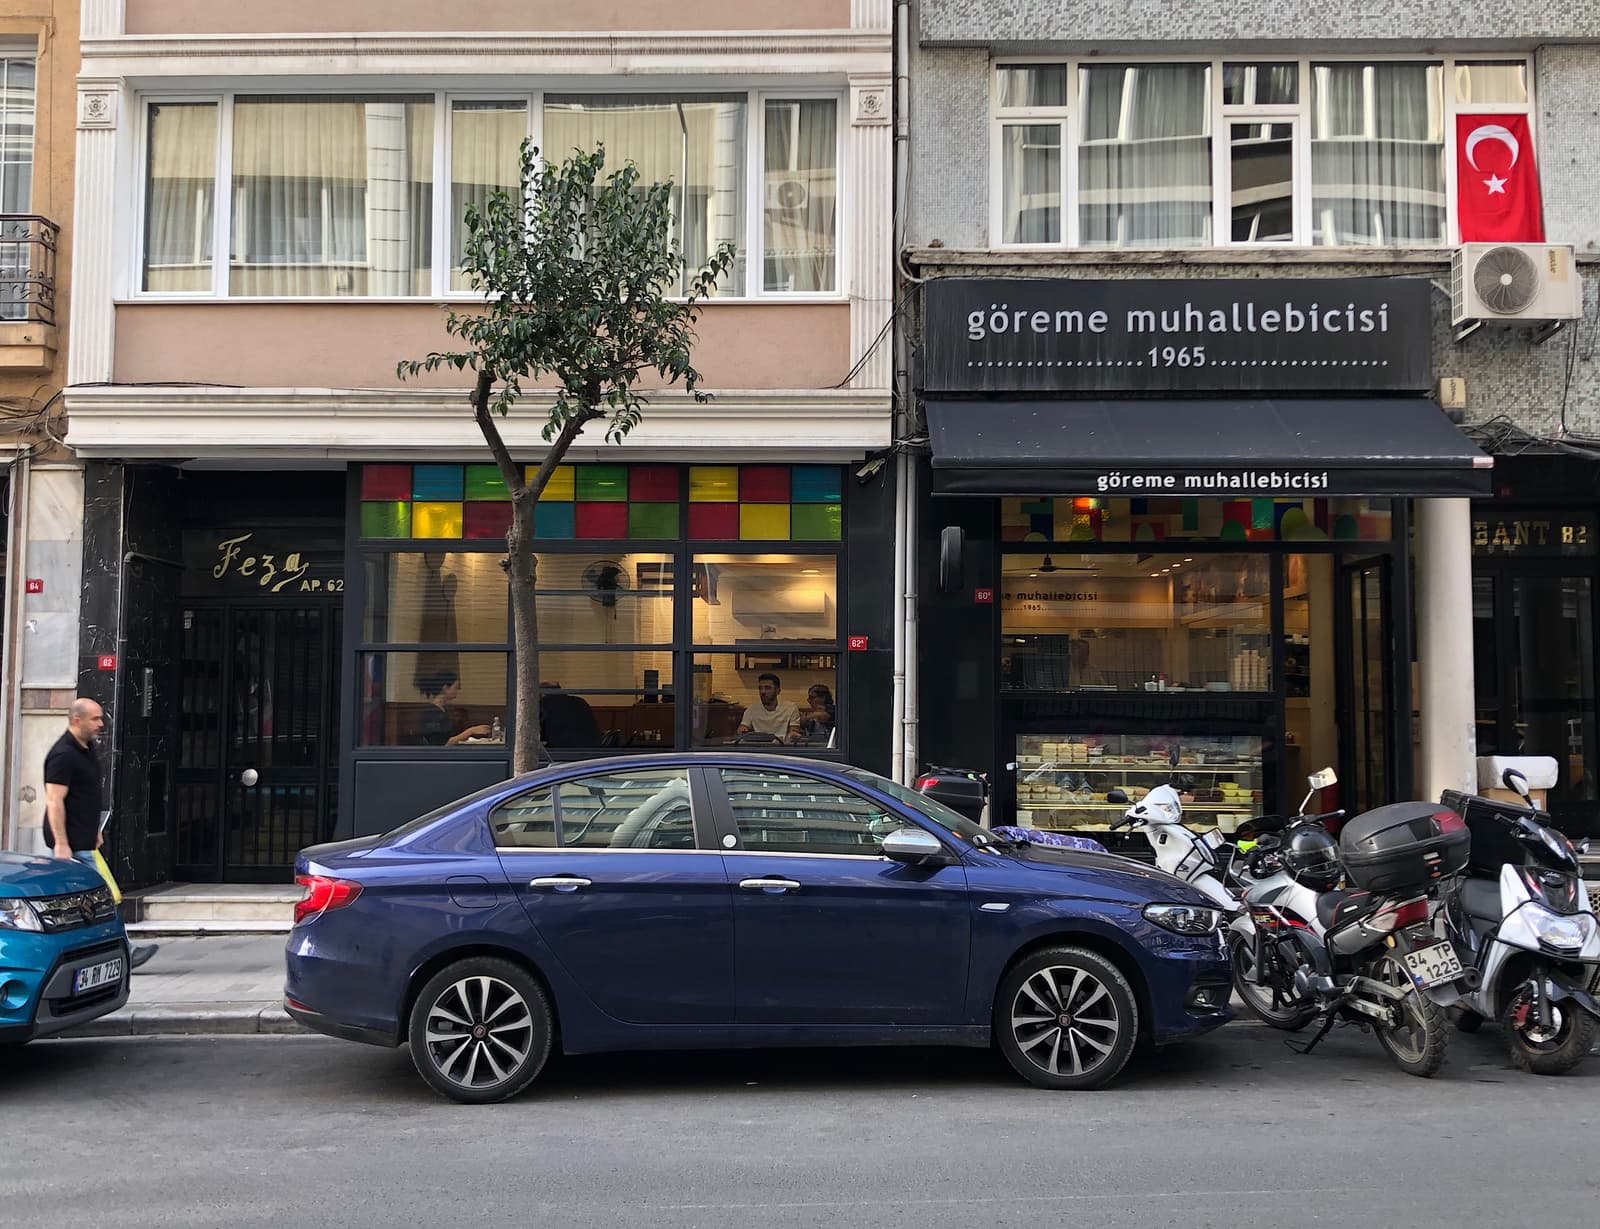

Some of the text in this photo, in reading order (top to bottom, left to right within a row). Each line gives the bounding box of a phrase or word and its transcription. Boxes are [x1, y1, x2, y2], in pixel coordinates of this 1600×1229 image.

[967, 302, 1388, 341] göreme muhallebicisi
[1096, 471, 1329, 491] göreme muhallebicisi
[213, 532, 344, 592] Feza AP. 62
[1016, 590, 1098, 601] muhallebicisi
[1407, 943, 1451, 969] 34 TP
[79, 969, 89, 989] 34
[1426, 957, 1460, 980] 1225
